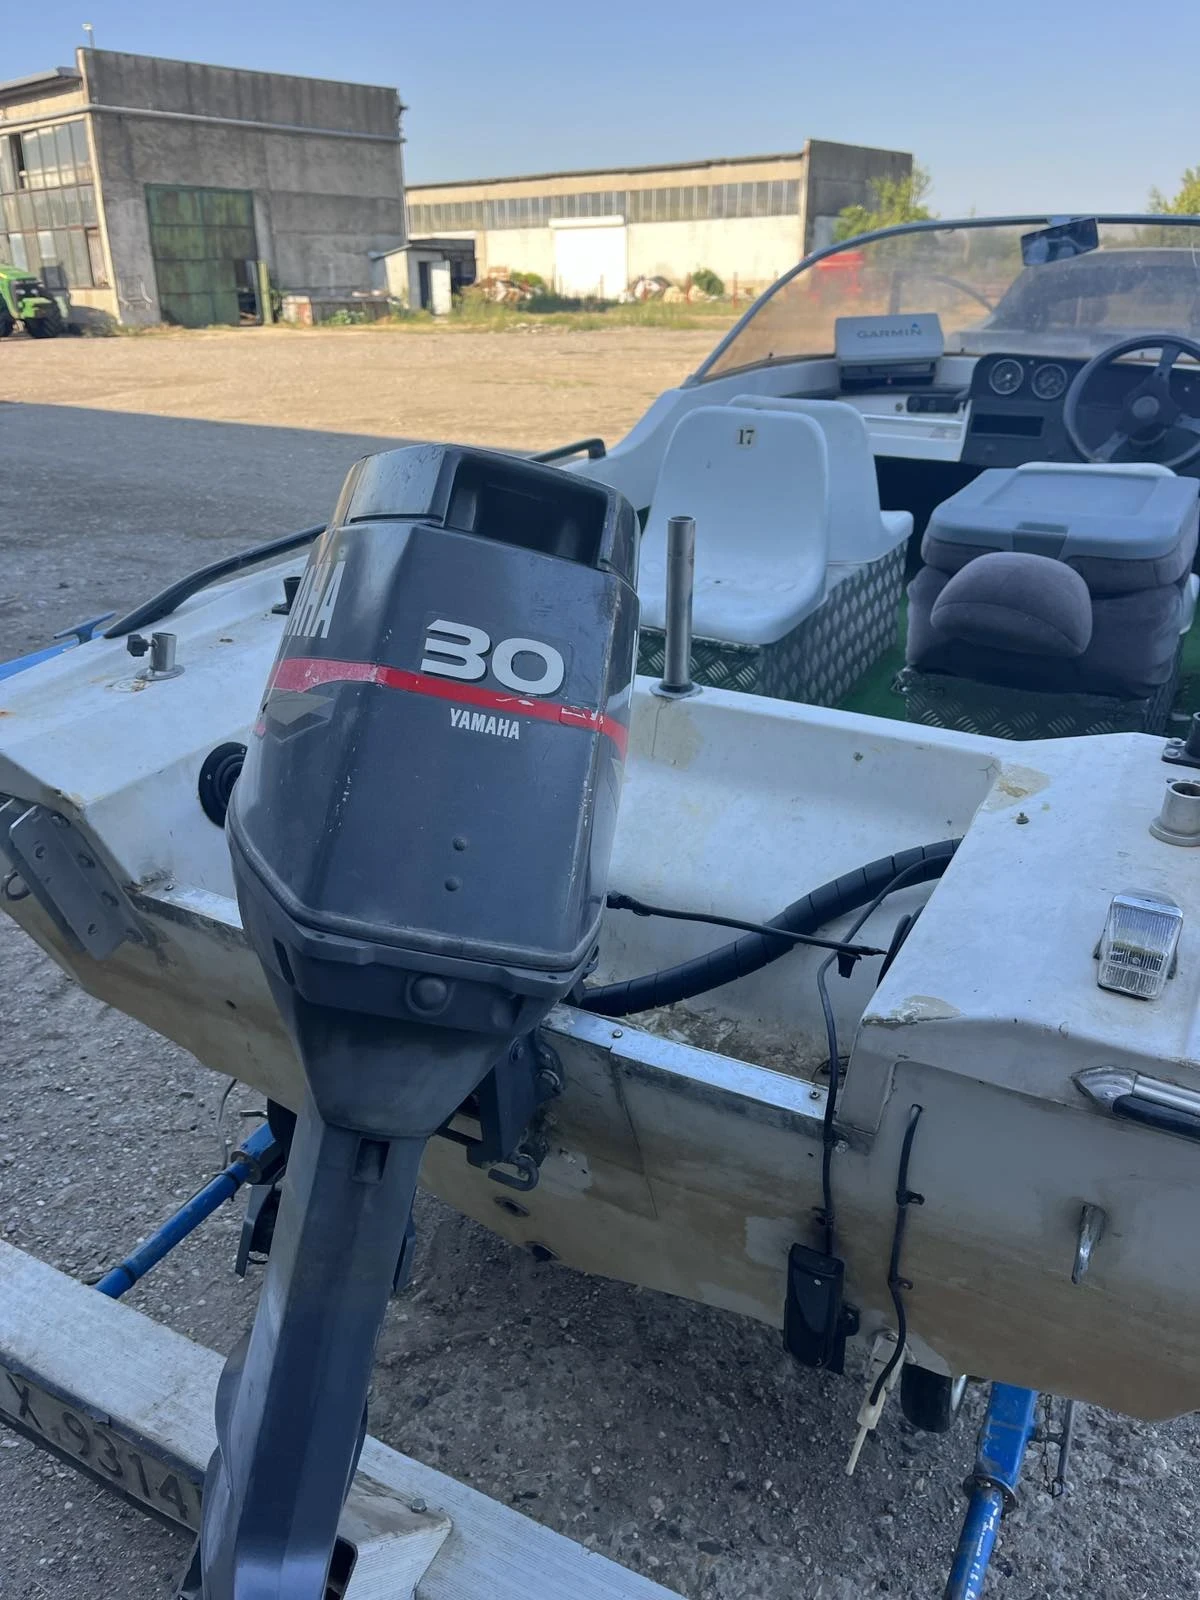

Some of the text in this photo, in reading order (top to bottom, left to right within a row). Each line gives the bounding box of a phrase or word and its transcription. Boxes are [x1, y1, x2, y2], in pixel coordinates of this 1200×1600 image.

[856, 327, 923, 339] GARMIN
[737, 429, 755, 445] 17
[420, 619, 566, 697] 30
[450, 707, 520, 740] YAMAHA
